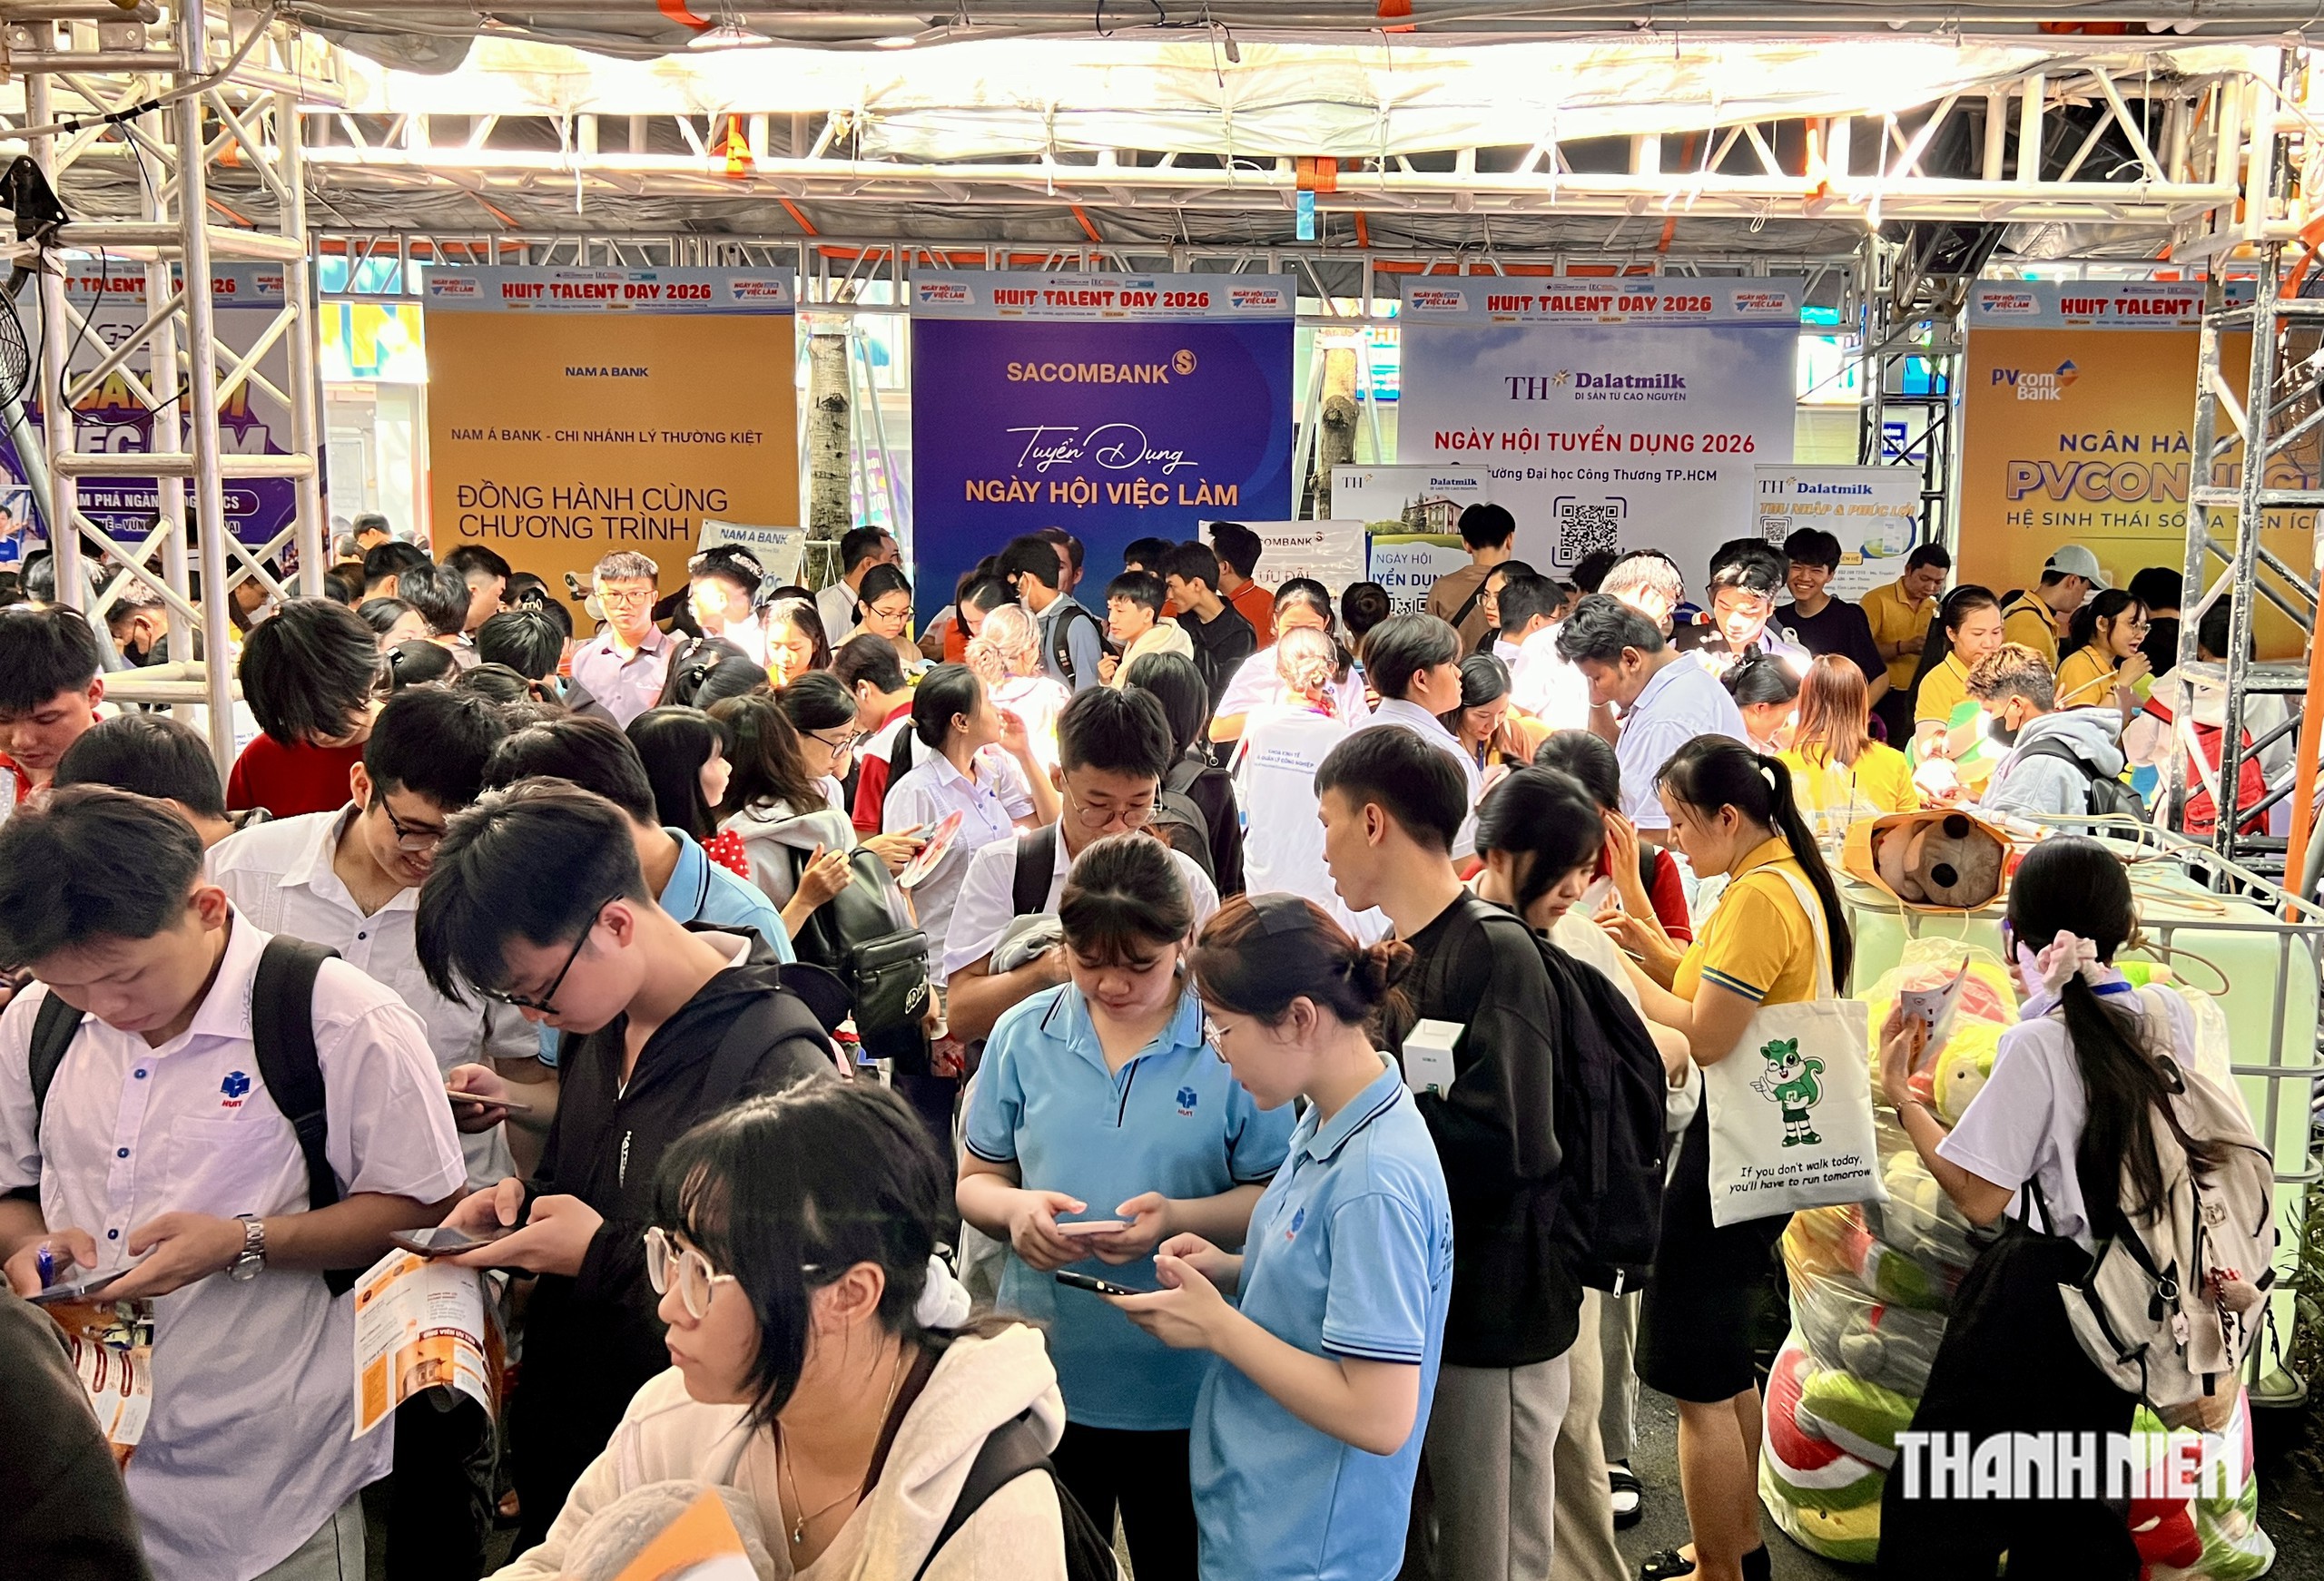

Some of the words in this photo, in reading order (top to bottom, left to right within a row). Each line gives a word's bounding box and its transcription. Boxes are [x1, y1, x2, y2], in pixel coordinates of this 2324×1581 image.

[502, 283, 544, 299] HUIT
[550, 283, 618, 299] TALENT
[624, 284, 660, 299] DAY
[666, 284, 711, 300] 2026
[994, 290, 1038, 305] HUIT
[1043, 290, 1114, 306] TALENT
[1120, 291, 1157, 307] DAY
[1163, 291, 1209, 308] 2026
[1488, 295, 1533, 311] HUIT
[1539, 295, 1612, 311] TALENT
[1619, 296, 1658, 312] DAY
[1663, 296, 1711, 312] 2026
[2061, 299, 2109, 314] HUIT
[2114, 299, 2192, 315] TALENT
[566, 367, 596, 377] NAM
[600, 367, 609, 377] A
[611, 367, 648, 378] BANK
[1007, 362, 1169, 384] SACOMBANK
[1575, 372, 1686, 390] Dalatmilk
[1992, 368, 2054, 387] PVcom
[1505, 377, 1549, 400] TH
[1575, 392, 1585, 400] DI
[1623, 392, 1644, 401] CAO
[2017, 385, 2062, 400] Bank
[451, 429, 483, 440] NAM
[487, 427, 497, 440] Á
[502, 430, 542, 441] BANK
[555, 430, 579, 442] CHI
[584, 427, 635, 442] NHÁNH
[639, 428, 656, 443] LÝ
[661, 429, 726, 444] THƯỜNG
[731, 429, 763, 446] KIỆT
[1434, 427, 1494, 451] NGÀY
[1502, 427, 1539, 454] HỘI
[1547, 424, 1621, 452] TUYỂN
[1630, 433, 1695, 456] DỤNG
[1701, 434, 1756, 454] 2026
[2060, 430, 2140, 453] NGÂN
[1007, 425, 1084, 473] Tuyển
[1083, 423, 1198, 475] Dụng
[1342, 476, 1363, 488] TH
[1430, 477, 1478, 486] Dalatmilk
[1527, 467, 1547, 482] Đại
[1551, 468, 1573, 482] học
[1577, 467, 1609, 483] Công
[1613, 468, 1661, 483] Thương
[1666, 469, 1718, 482] TP.HCM
[457, 478, 543, 509] ĐỒNG
[552, 482, 634, 511] HÀNH
[642, 483, 727, 512] CÙNG
[965, 475, 1041, 503] NGÀY
[1049, 476, 1098, 508] HỘI
[1106, 476, 1169, 509] VIỆC
[1178, 478, 1237, 506] LÀM
[1759, 480, 1784, 494] TH
[1797, 482, 1873, 496] Dalatmilk
[1834, 505, 1845, 516] &
[2007, 510, 2034, 529] HỆ
[2043, 512, 2092, 527] SINH
[2101, 510, 2149, 528] THÁI
[2158, 509, 2185, 528] SỐ
[459, 514, 593, 539] CHƯƠNG
[601, 511, 689, 541] TRÌNH
[720, 528, 746, 540] NAM
[749, 530, 755, 542] A
[757, 532, 788, 545] BANK
[1376, 554, 1407, 564] NGÀY
[1412, 554, 1432, 565] HỘI
[1741, 1167, 1752, 1178] If
[1756, 1167, 1775, 1179] you
[1777, 1162, 1802, 1174] don't
[1806, 1158, 1828, 1171] walk
[1832, 1154, 1863, 1167] today,
[1729, 1180, 1757, 1194] you'll
[1760, 1178, 1785, 1190] have
[1788, 1178, 1798, 1187] to
[1802, 1175, 1819, 1185] run
